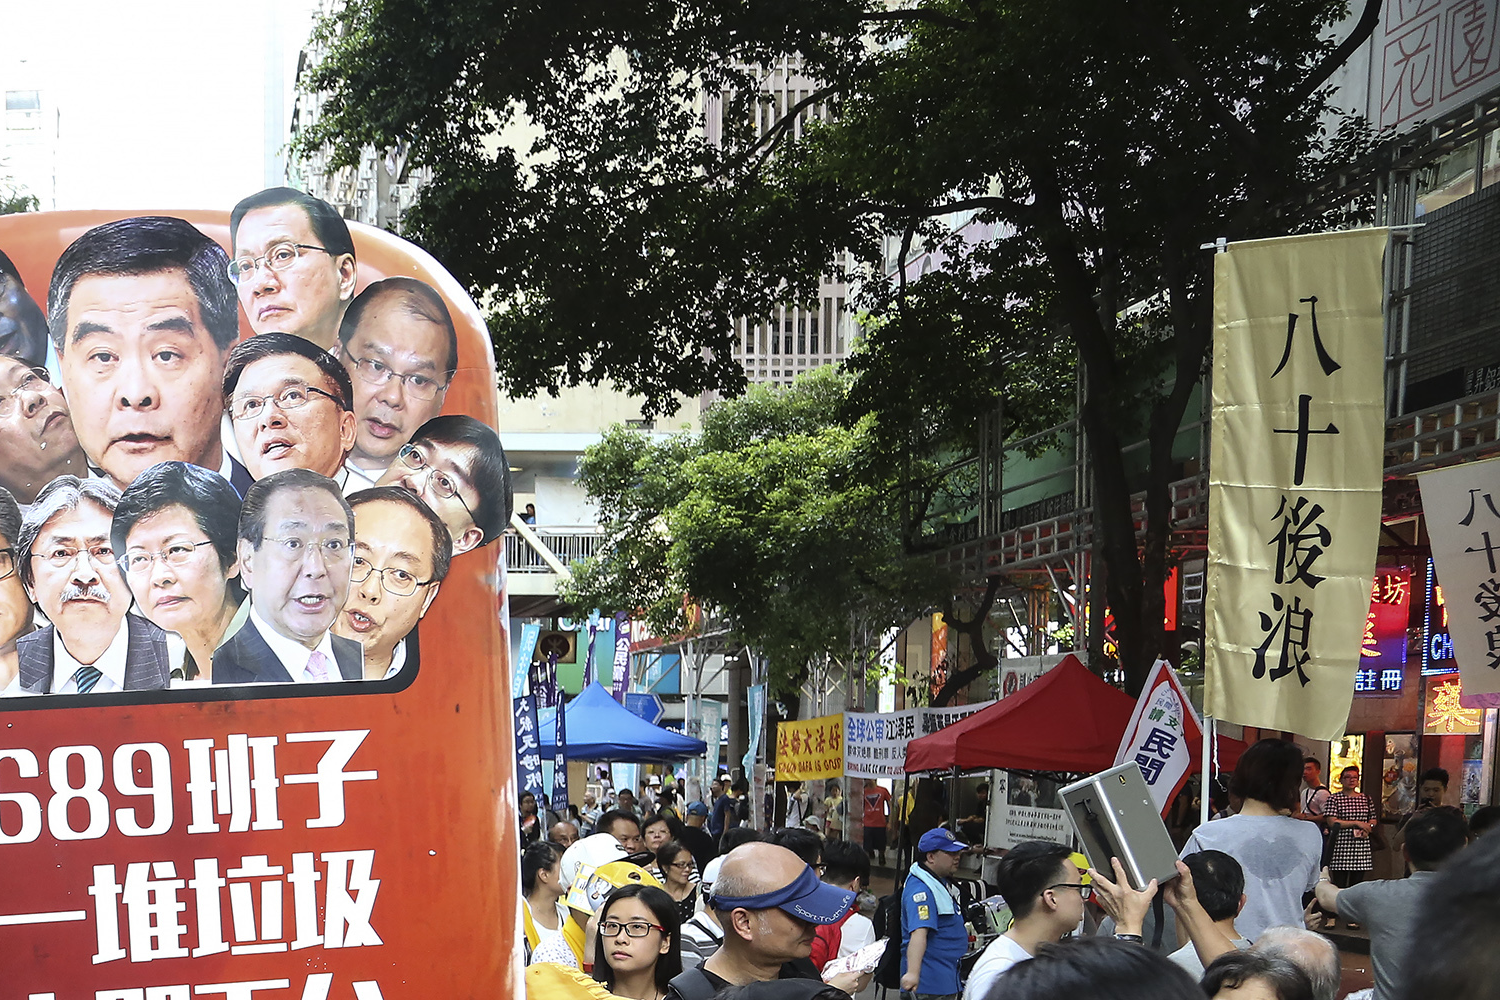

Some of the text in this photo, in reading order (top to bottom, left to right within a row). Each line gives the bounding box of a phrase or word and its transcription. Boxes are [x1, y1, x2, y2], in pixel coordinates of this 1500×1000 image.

[1250, 295, 1342, 688] 八十後浪
[1355, 669, 1401, 691] 註冊
[1134, 727, 1178, 786] 民間
